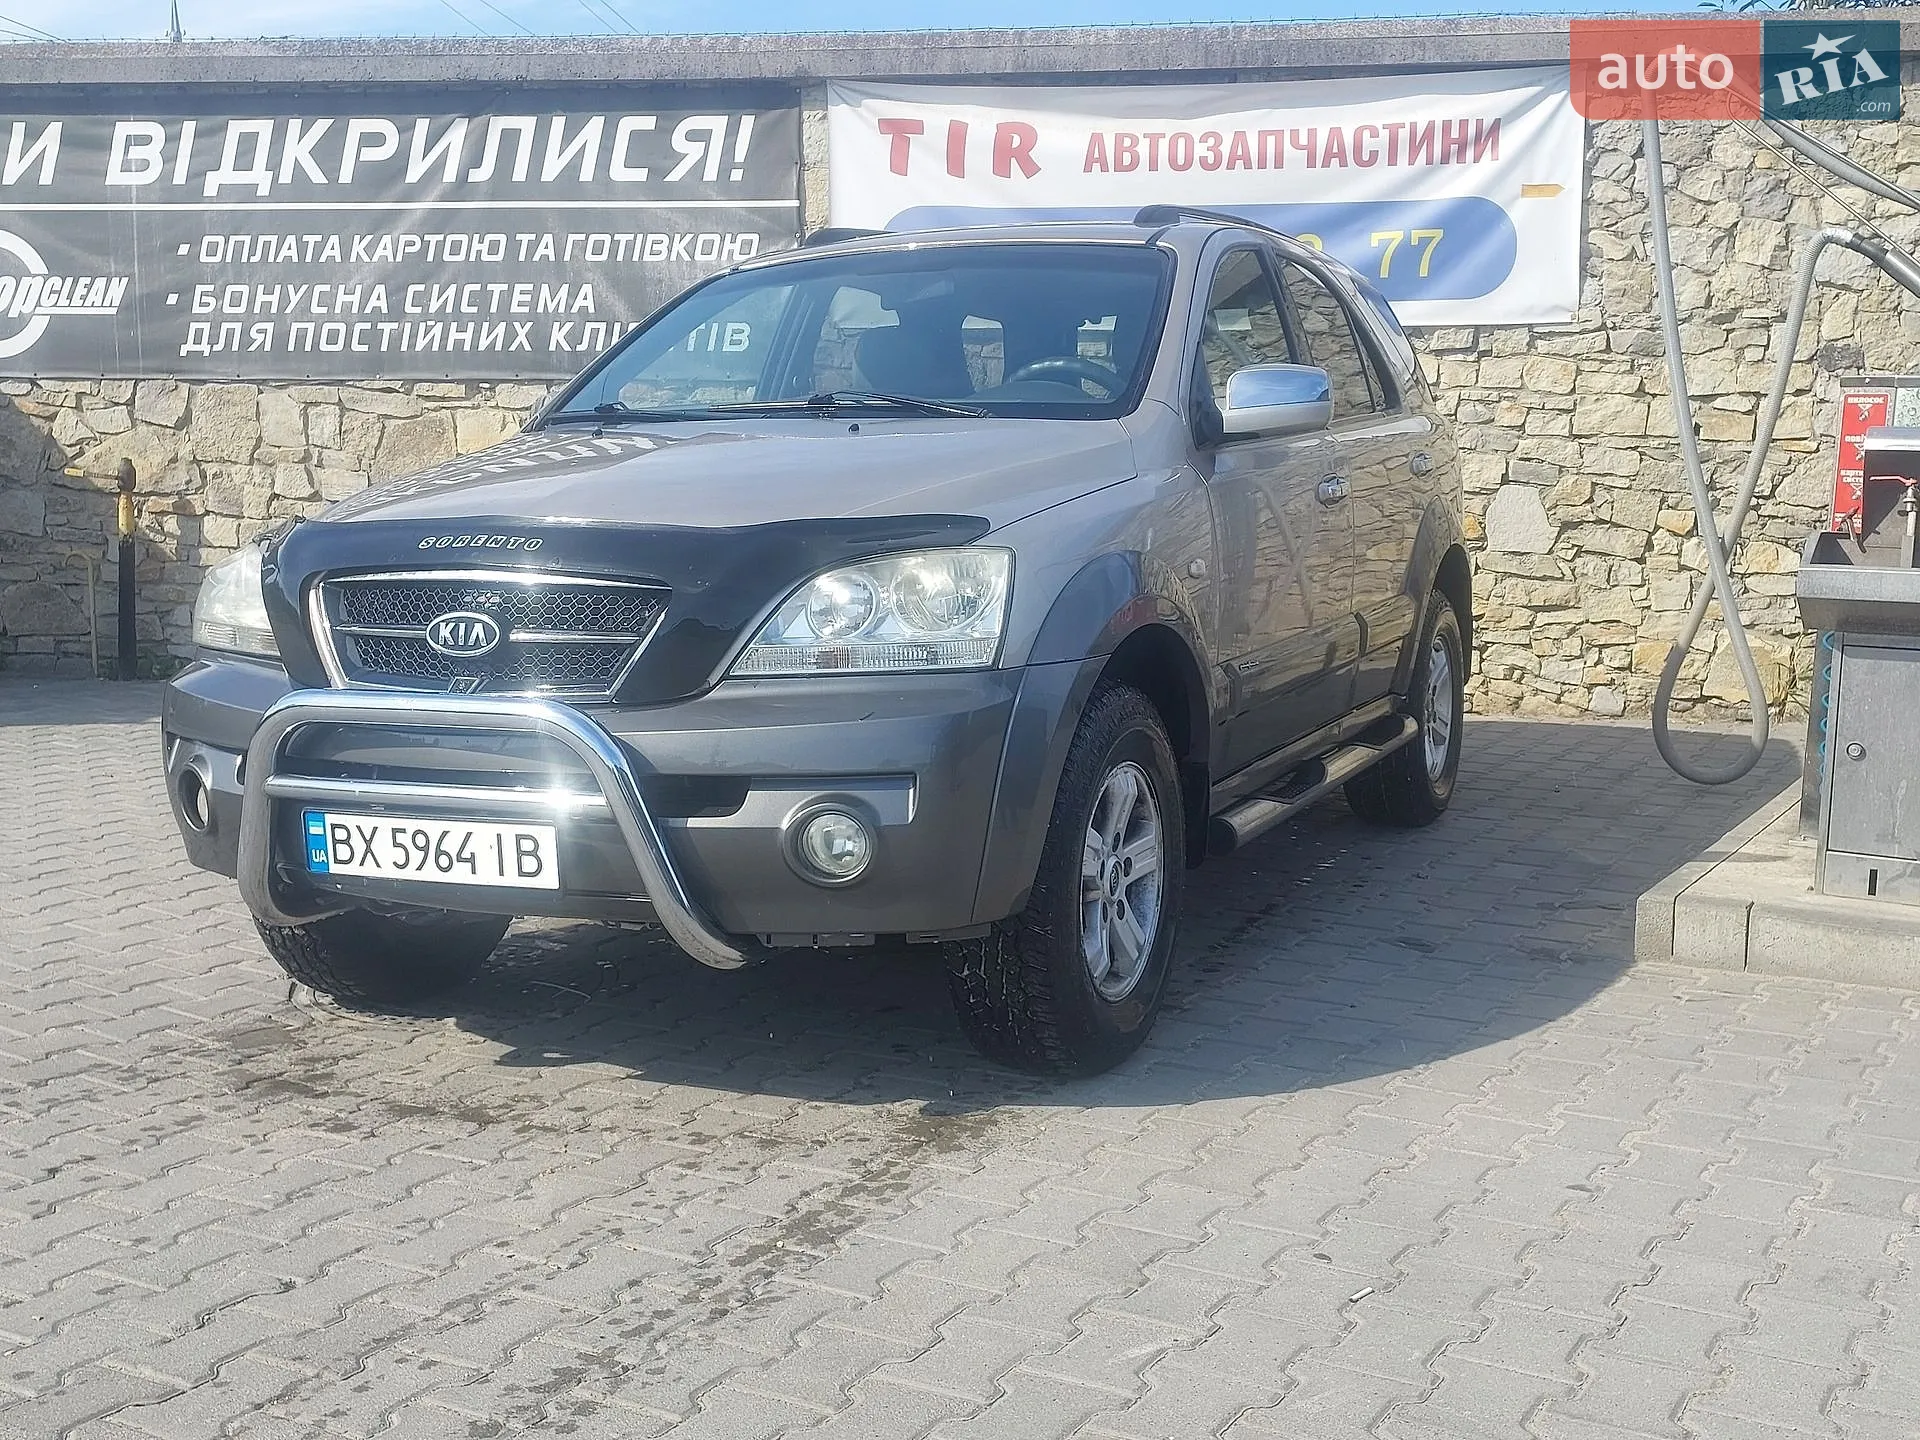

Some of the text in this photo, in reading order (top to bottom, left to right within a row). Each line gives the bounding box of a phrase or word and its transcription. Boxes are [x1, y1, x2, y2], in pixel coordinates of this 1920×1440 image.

[104, 115, 756, 197] ВІДКРИЛИСЯ!
[878, 116, 1503, 180] TIR АВТОЗАПЧАСТИНИ
[198, 232, 761, 264] ОПЛАТА КАРТОЮ ТА ГОТІВКОЮ
[1370, 228, 1445, 279] 77
[191, 283, 596, 315] БОНУСНА СИСТЕМА
[179, 321, 752, 357] ДЛЯ ПОСТІЙНИХ КЛІТІВ
[418, 534, 544, 551] SORENTO
[438, 621, 488, 647] KIA
[311, 848, 328, 864] UA
[329, 822, 544, 879] BX 5964 IB
